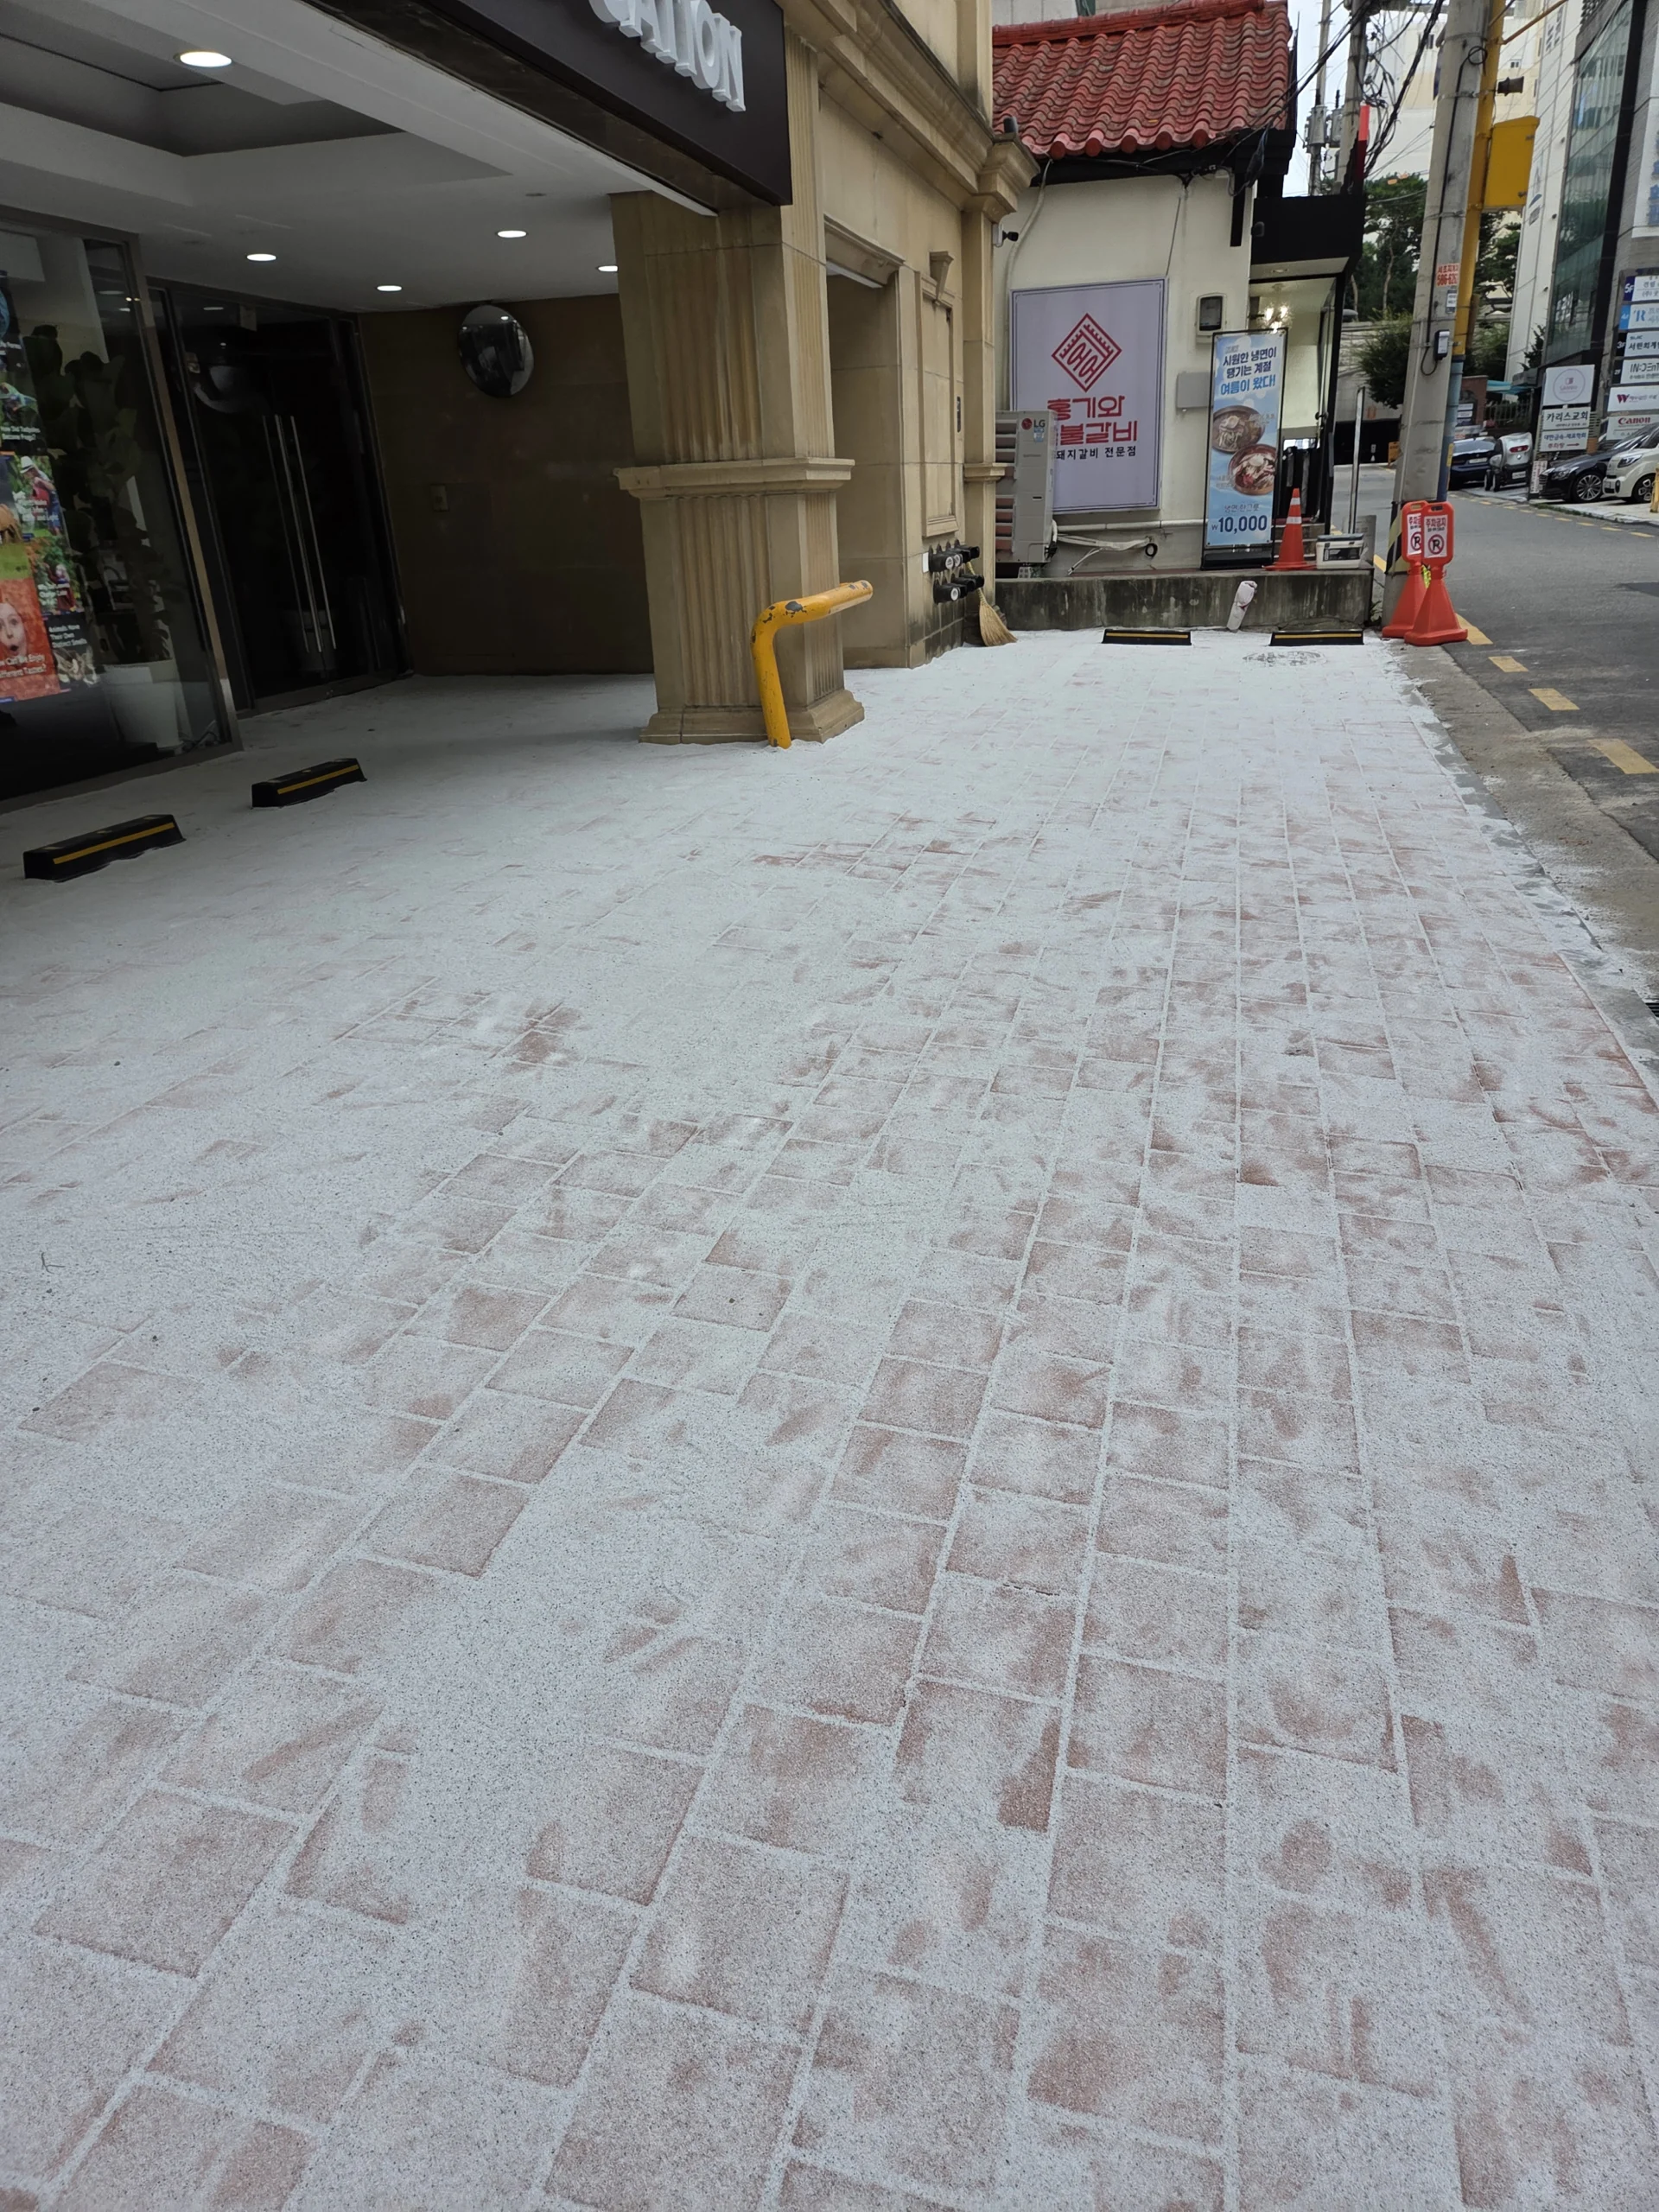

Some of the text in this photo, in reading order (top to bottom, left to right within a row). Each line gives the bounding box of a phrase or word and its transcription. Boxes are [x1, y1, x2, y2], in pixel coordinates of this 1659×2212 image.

[1224, 352, 1249, 366] 시원한
[1251, 346, 1277, 362] 냉면이
[1227, 360, 1272, 378] 땡기는 계절
[1220, 374, 1276, 396] 여름이 왔다!
[1033, 419, 1046, 428] LG
[1546, 410, 1588, 423] 카리스교회
[1618, 416, 1651, 425] Canon
[1055, 420, 1138, 446] 불갈비
[1056, 446, 1137, 461] 돼지갈비 전문점
[1224, 504, 1238, 513] 냉면
[1426, 517, 1446, 529] 주차금지
